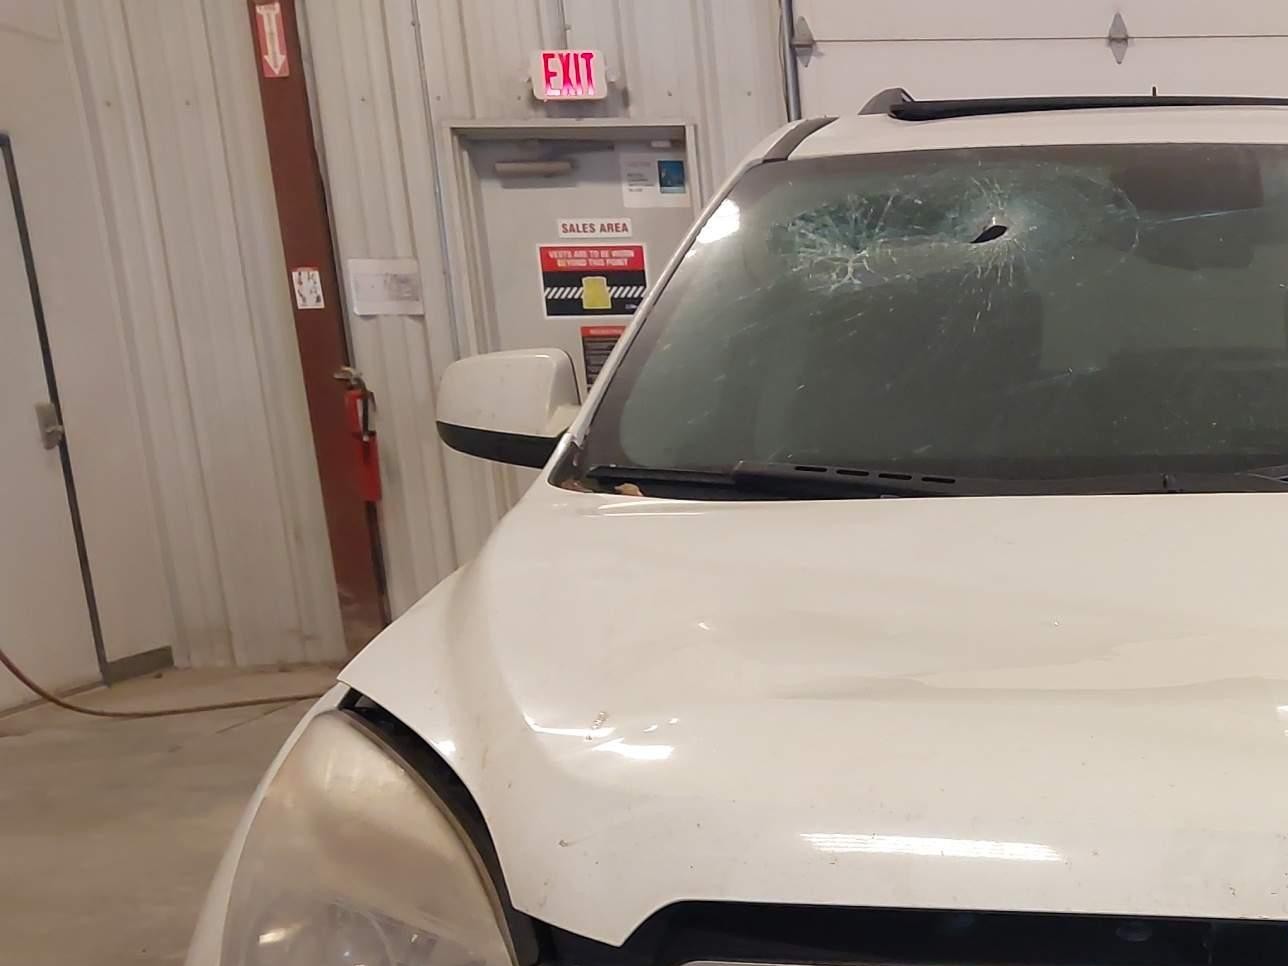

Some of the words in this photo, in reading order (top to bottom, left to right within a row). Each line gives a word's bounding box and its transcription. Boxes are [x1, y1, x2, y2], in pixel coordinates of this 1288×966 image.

[542, 52, 594, 96] EXIT
[561, 223, 596, 233] SALES
[599, 222, 629, 233] AREA
